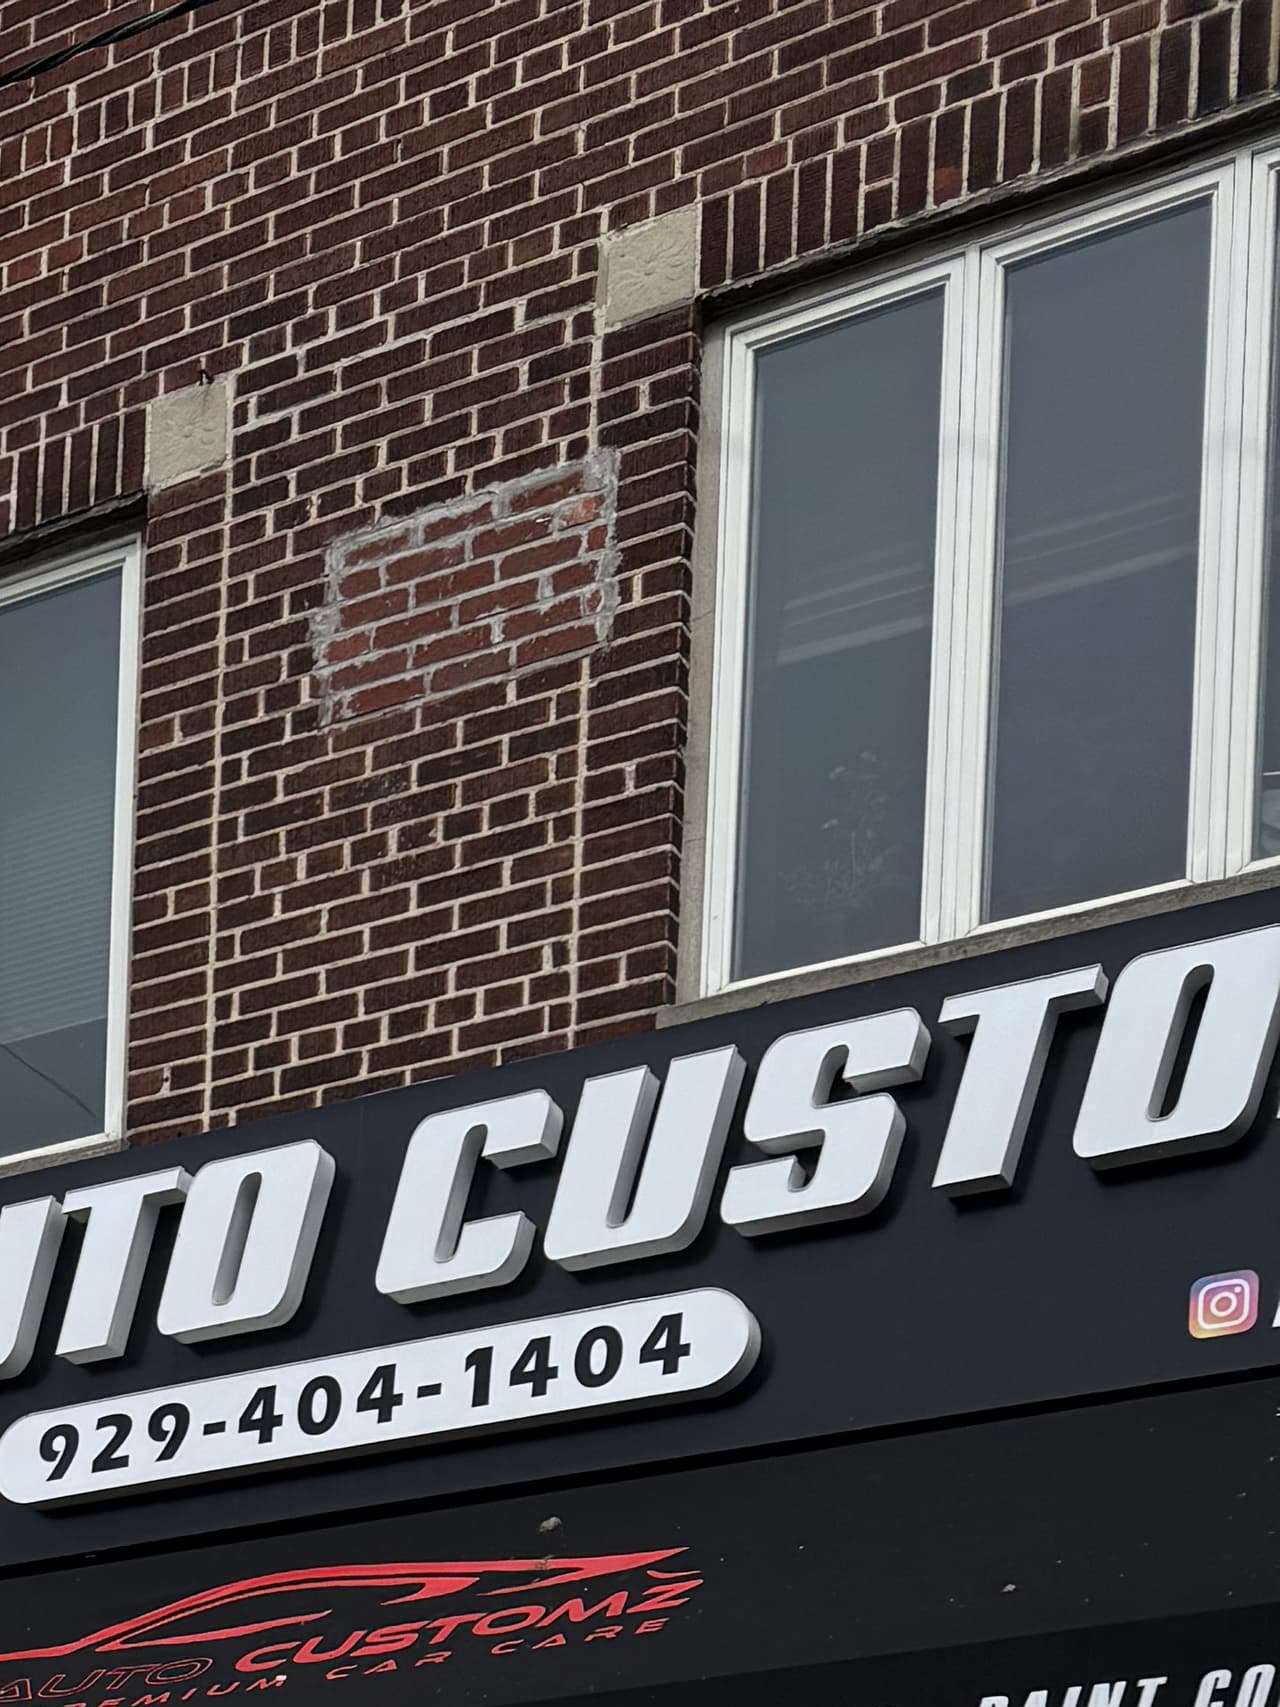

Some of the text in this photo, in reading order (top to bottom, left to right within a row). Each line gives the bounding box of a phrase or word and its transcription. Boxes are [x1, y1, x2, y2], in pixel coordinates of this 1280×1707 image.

[374, 923, 1280, 1304] CUSTO
[39, 1313, 694, 1484] 929-404-1404
[235, 1570, 703, 1673] CUSTOMZ
[326, 1650, 448, 1681] CAR
[491, 1618, 666, 1657] CARE
